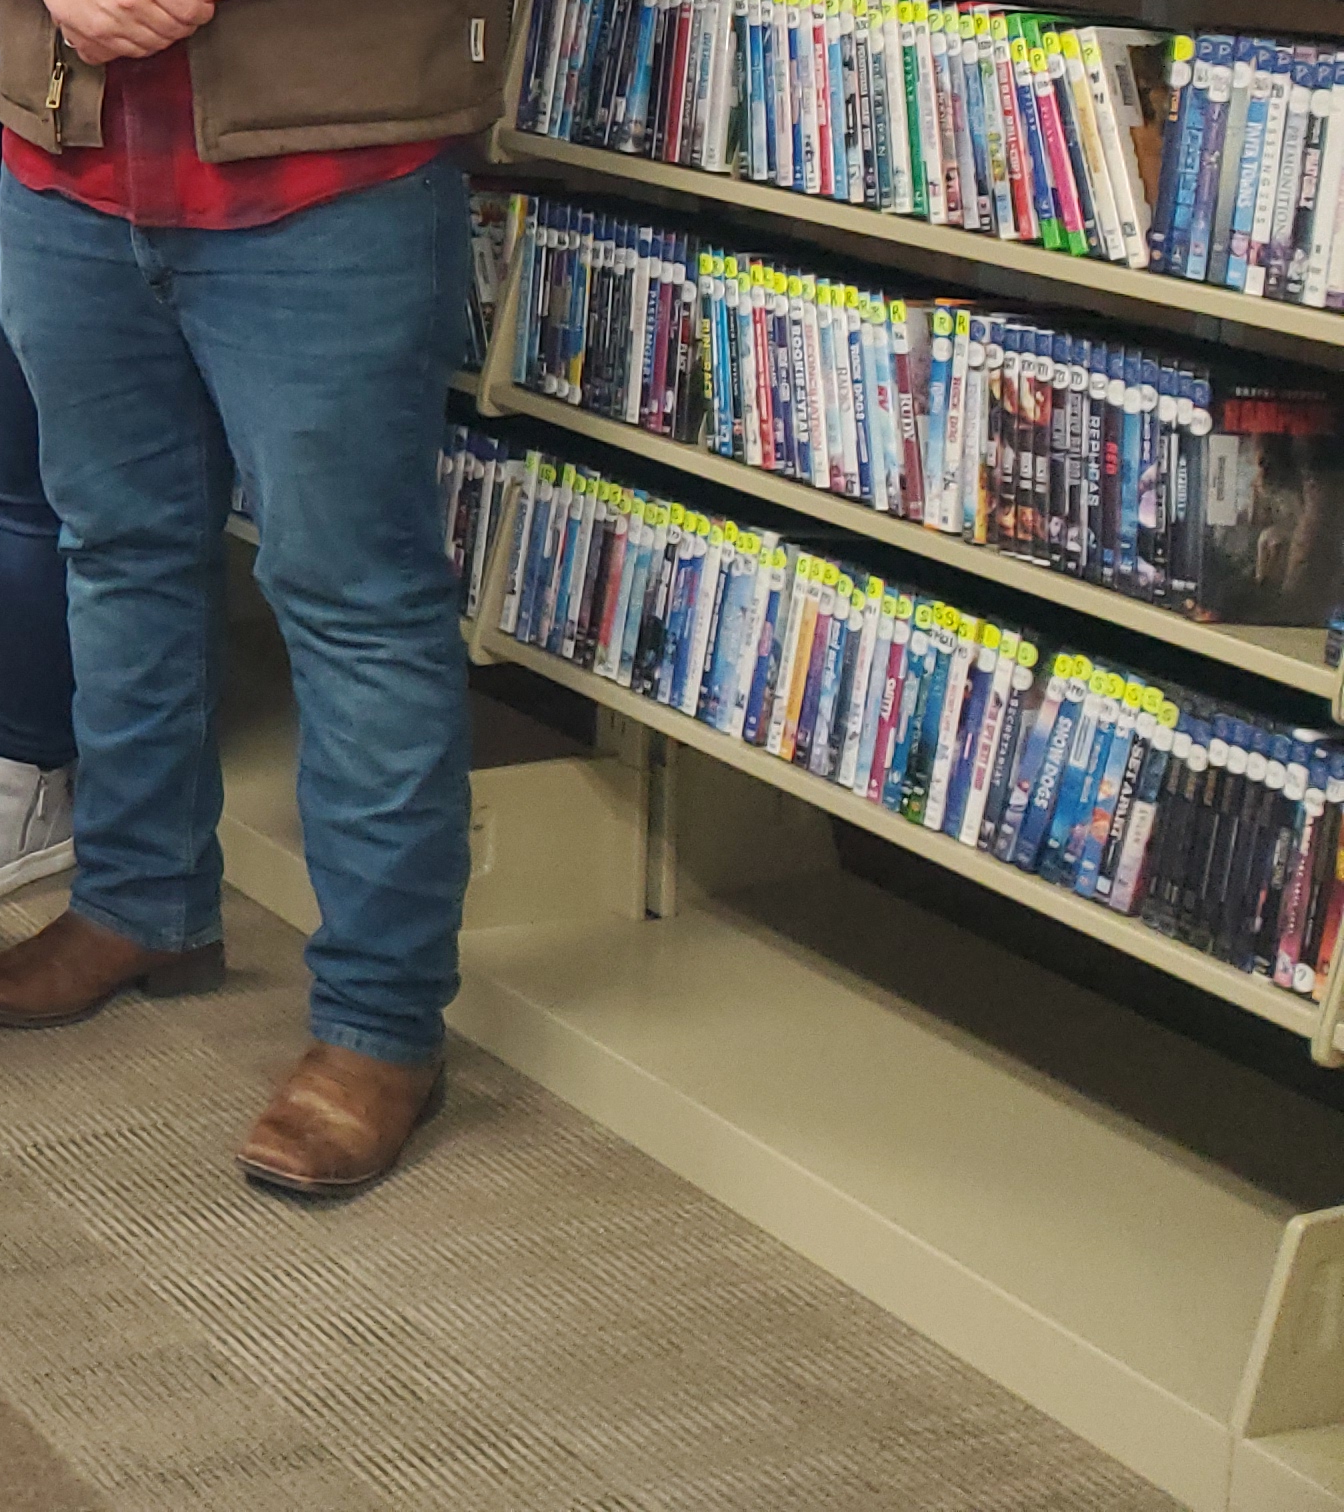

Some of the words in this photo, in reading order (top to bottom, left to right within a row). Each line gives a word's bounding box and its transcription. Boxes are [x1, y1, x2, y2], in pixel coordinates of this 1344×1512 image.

[1275, 124, 1300, 238] PREMONITION
[898, 392, 915, 439] RUDY
[1034, 763, 1060, 810] DOGS
